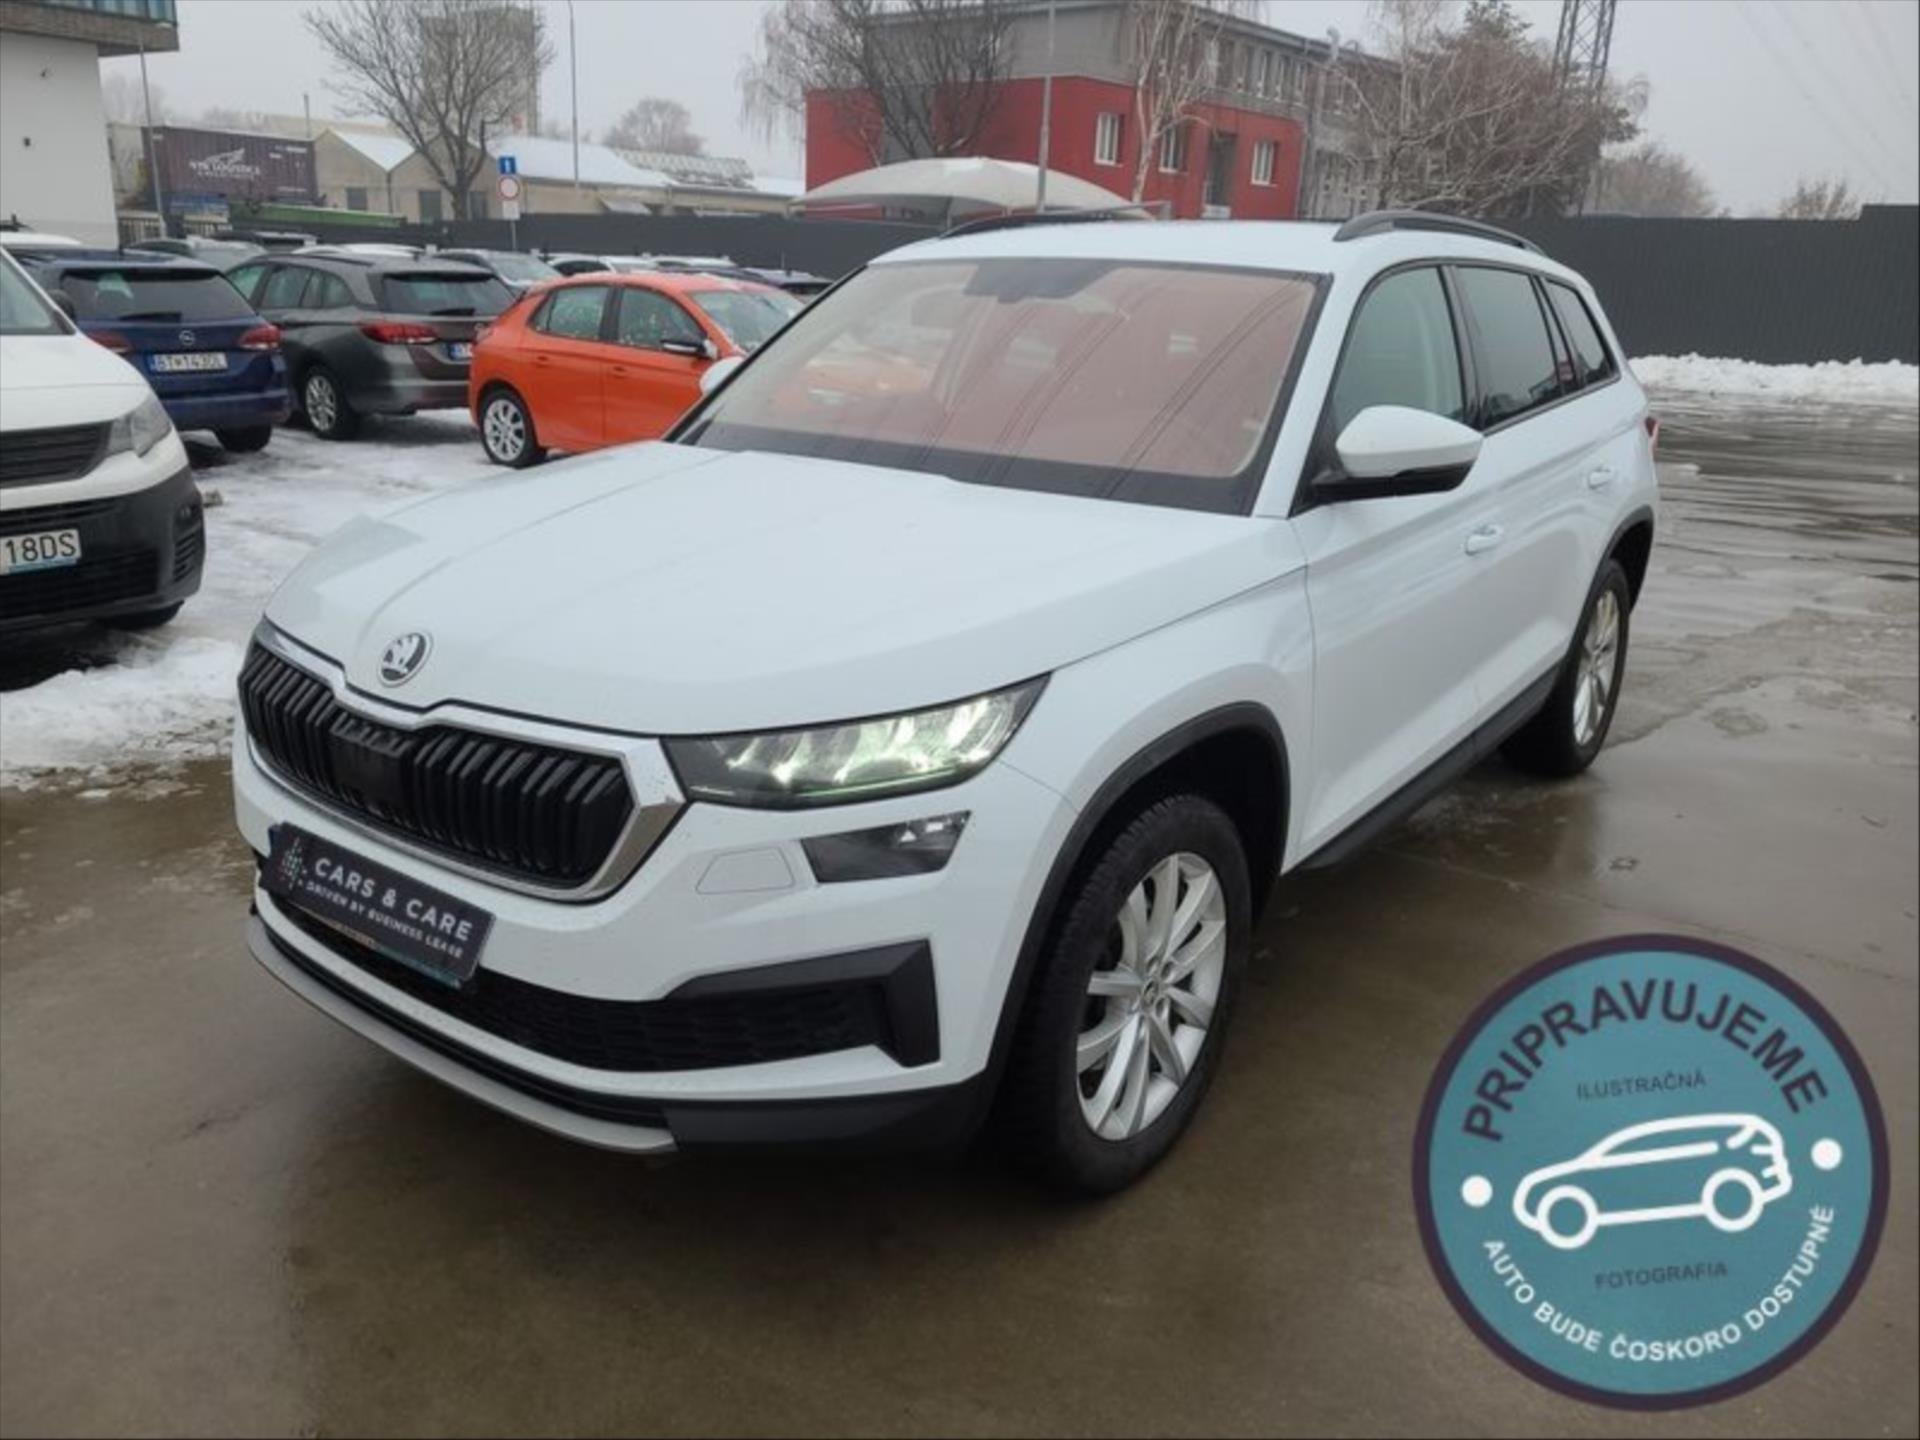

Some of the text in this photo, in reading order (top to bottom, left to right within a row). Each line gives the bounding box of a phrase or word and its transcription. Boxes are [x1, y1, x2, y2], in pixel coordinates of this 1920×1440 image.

[306, 882, 463, 958] DRIVEN BY BUSINESS LEASE
[315, 857, 473, 941] CARS & CARE
